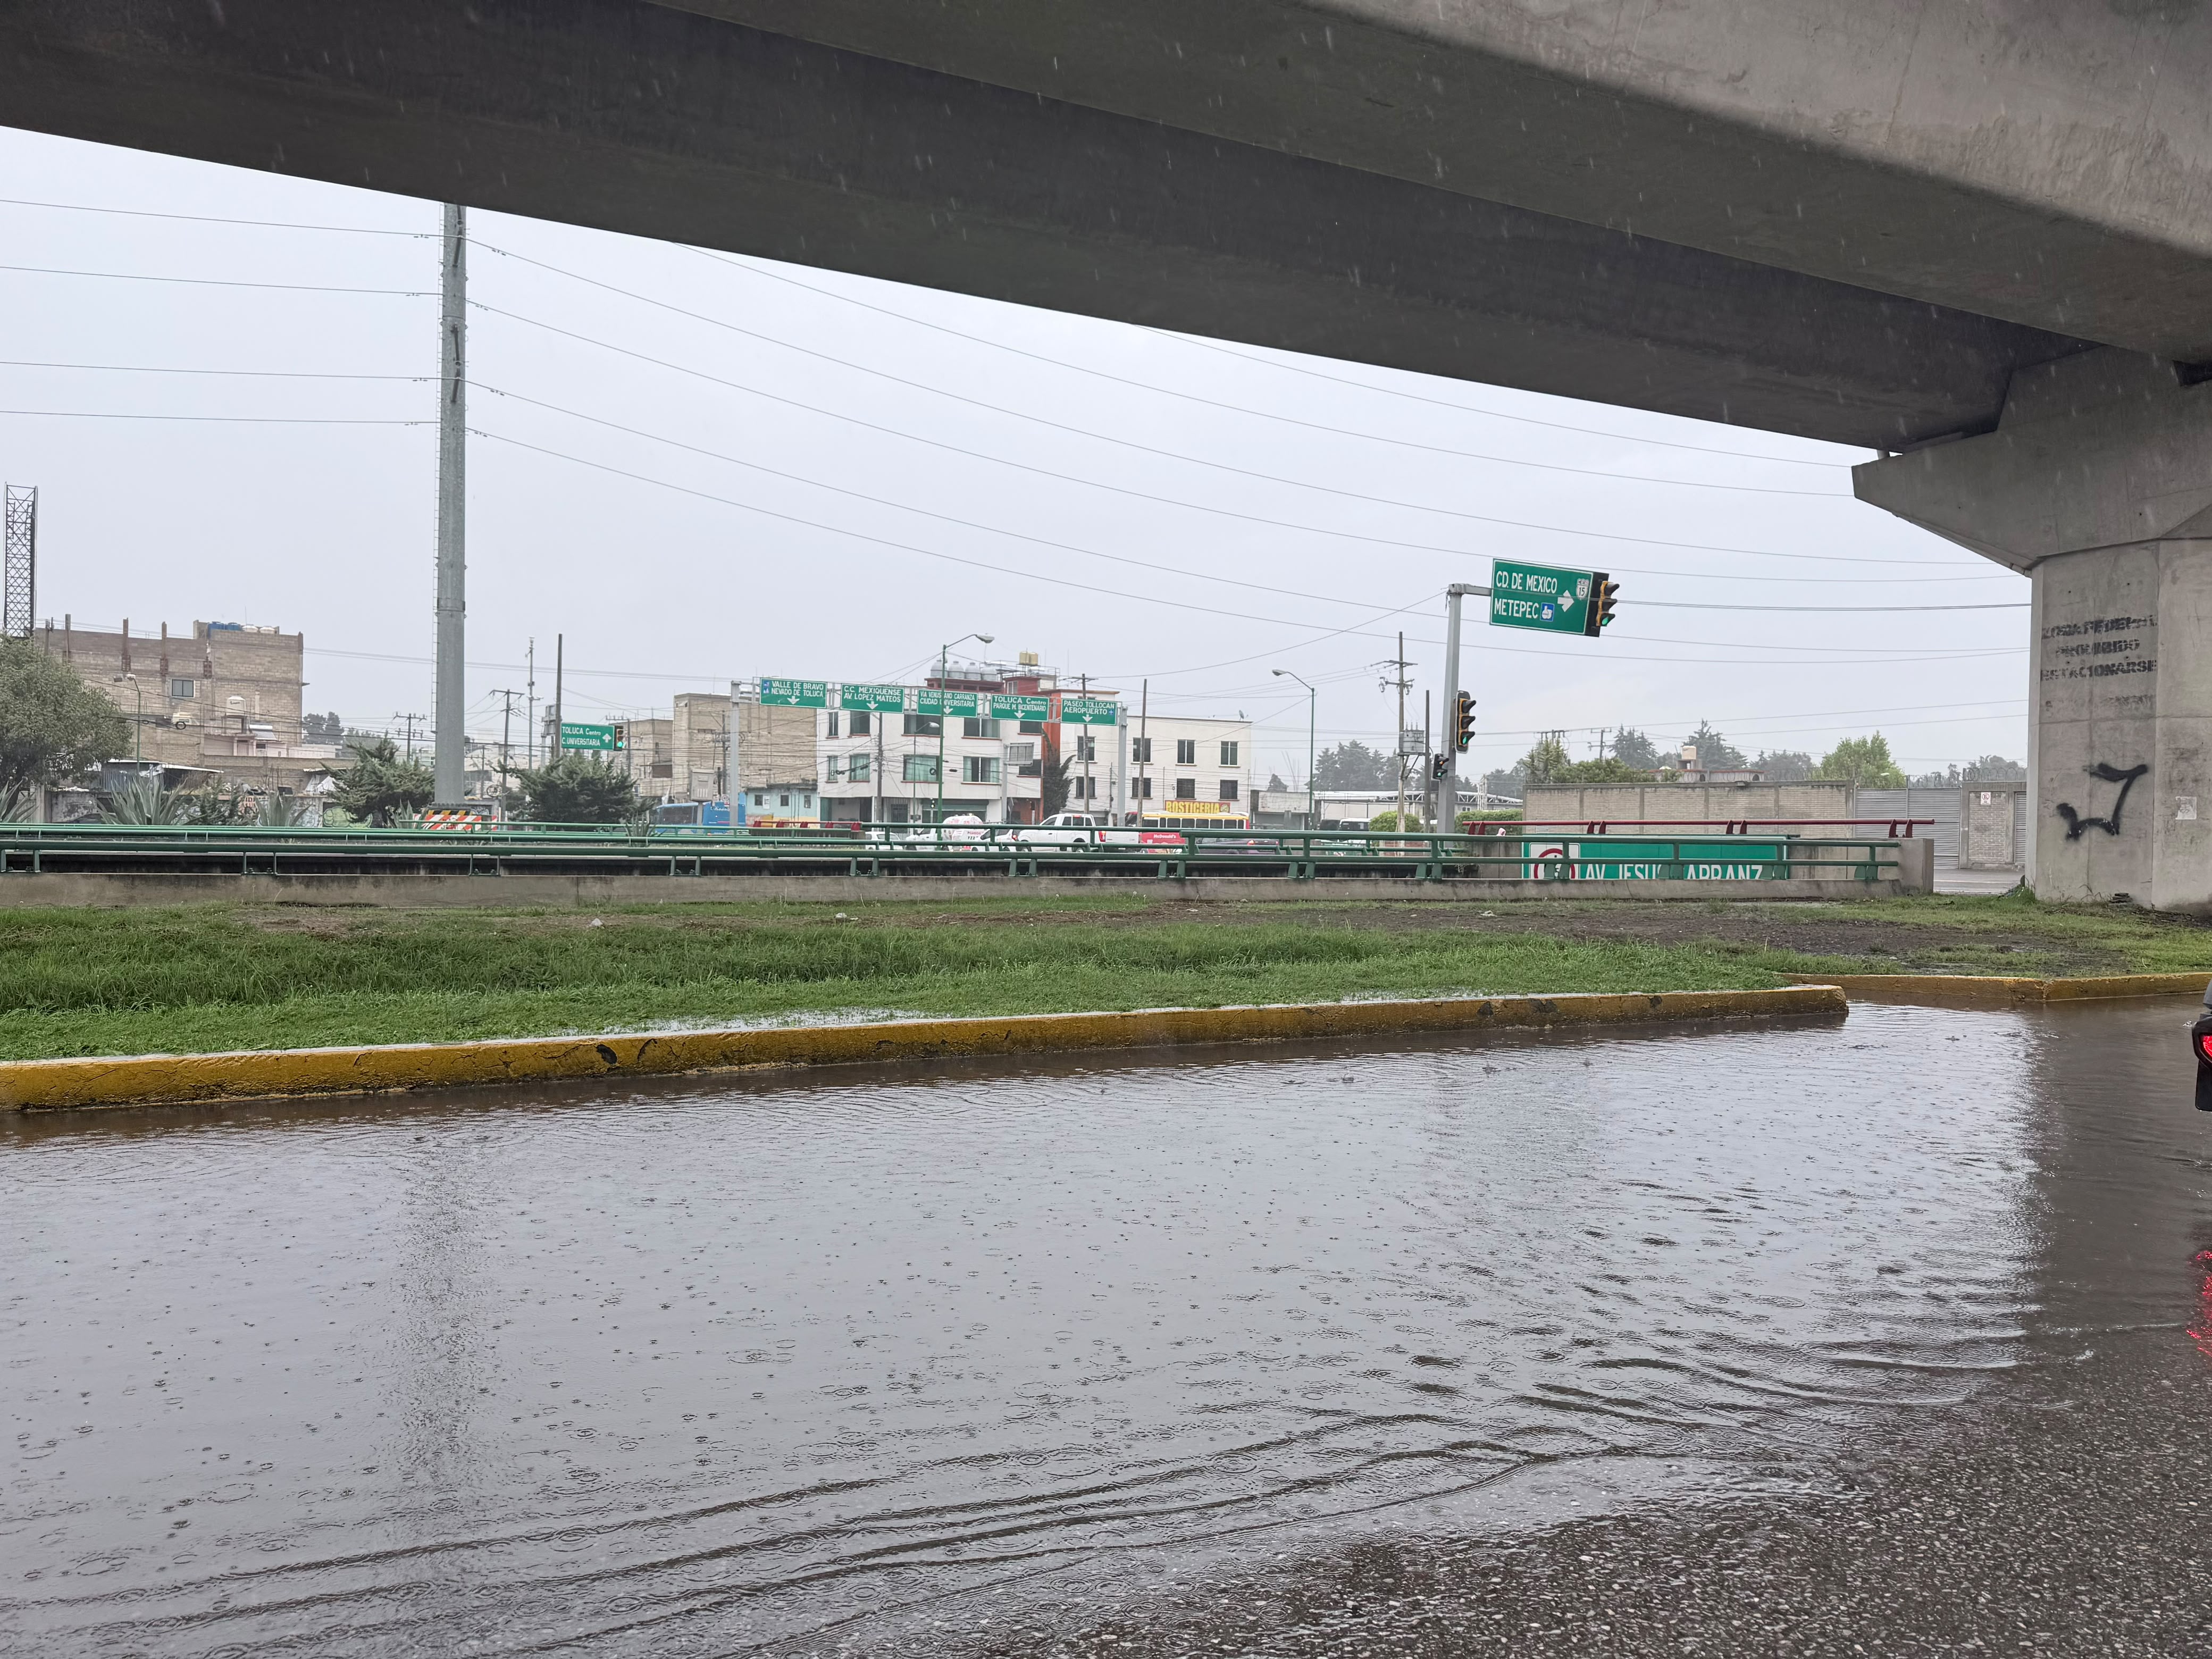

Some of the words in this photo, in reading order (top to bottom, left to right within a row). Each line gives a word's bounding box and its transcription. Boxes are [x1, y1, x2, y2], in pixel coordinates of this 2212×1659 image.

[1496, 571, 1509, 588] CD.
[1511, 572, 1523, 590] DE
[1526, 574, 1557, 594] MEXICO
[1579, 586, 1586, 597] 15
[1494, 597, 1539, 619] METEPEC
[2040, 659, 2157, 681] ESTACIONARSE
[858, 686, 901, 696] MEXIQUENSE
[1017, 703, 1047, 712] BICENTENARIO
[1063, 707, 1108, 715] AEROPUERTO
[562, 726, 584, 735] TOLUCA
[585, 727, 601, 736] Centro
[567, 737, 600, 747] UNIVERSITARIA
[1166, 801, 1220, 814] ROSTICERIA
[1619, 864, 1662, 880] JESU
